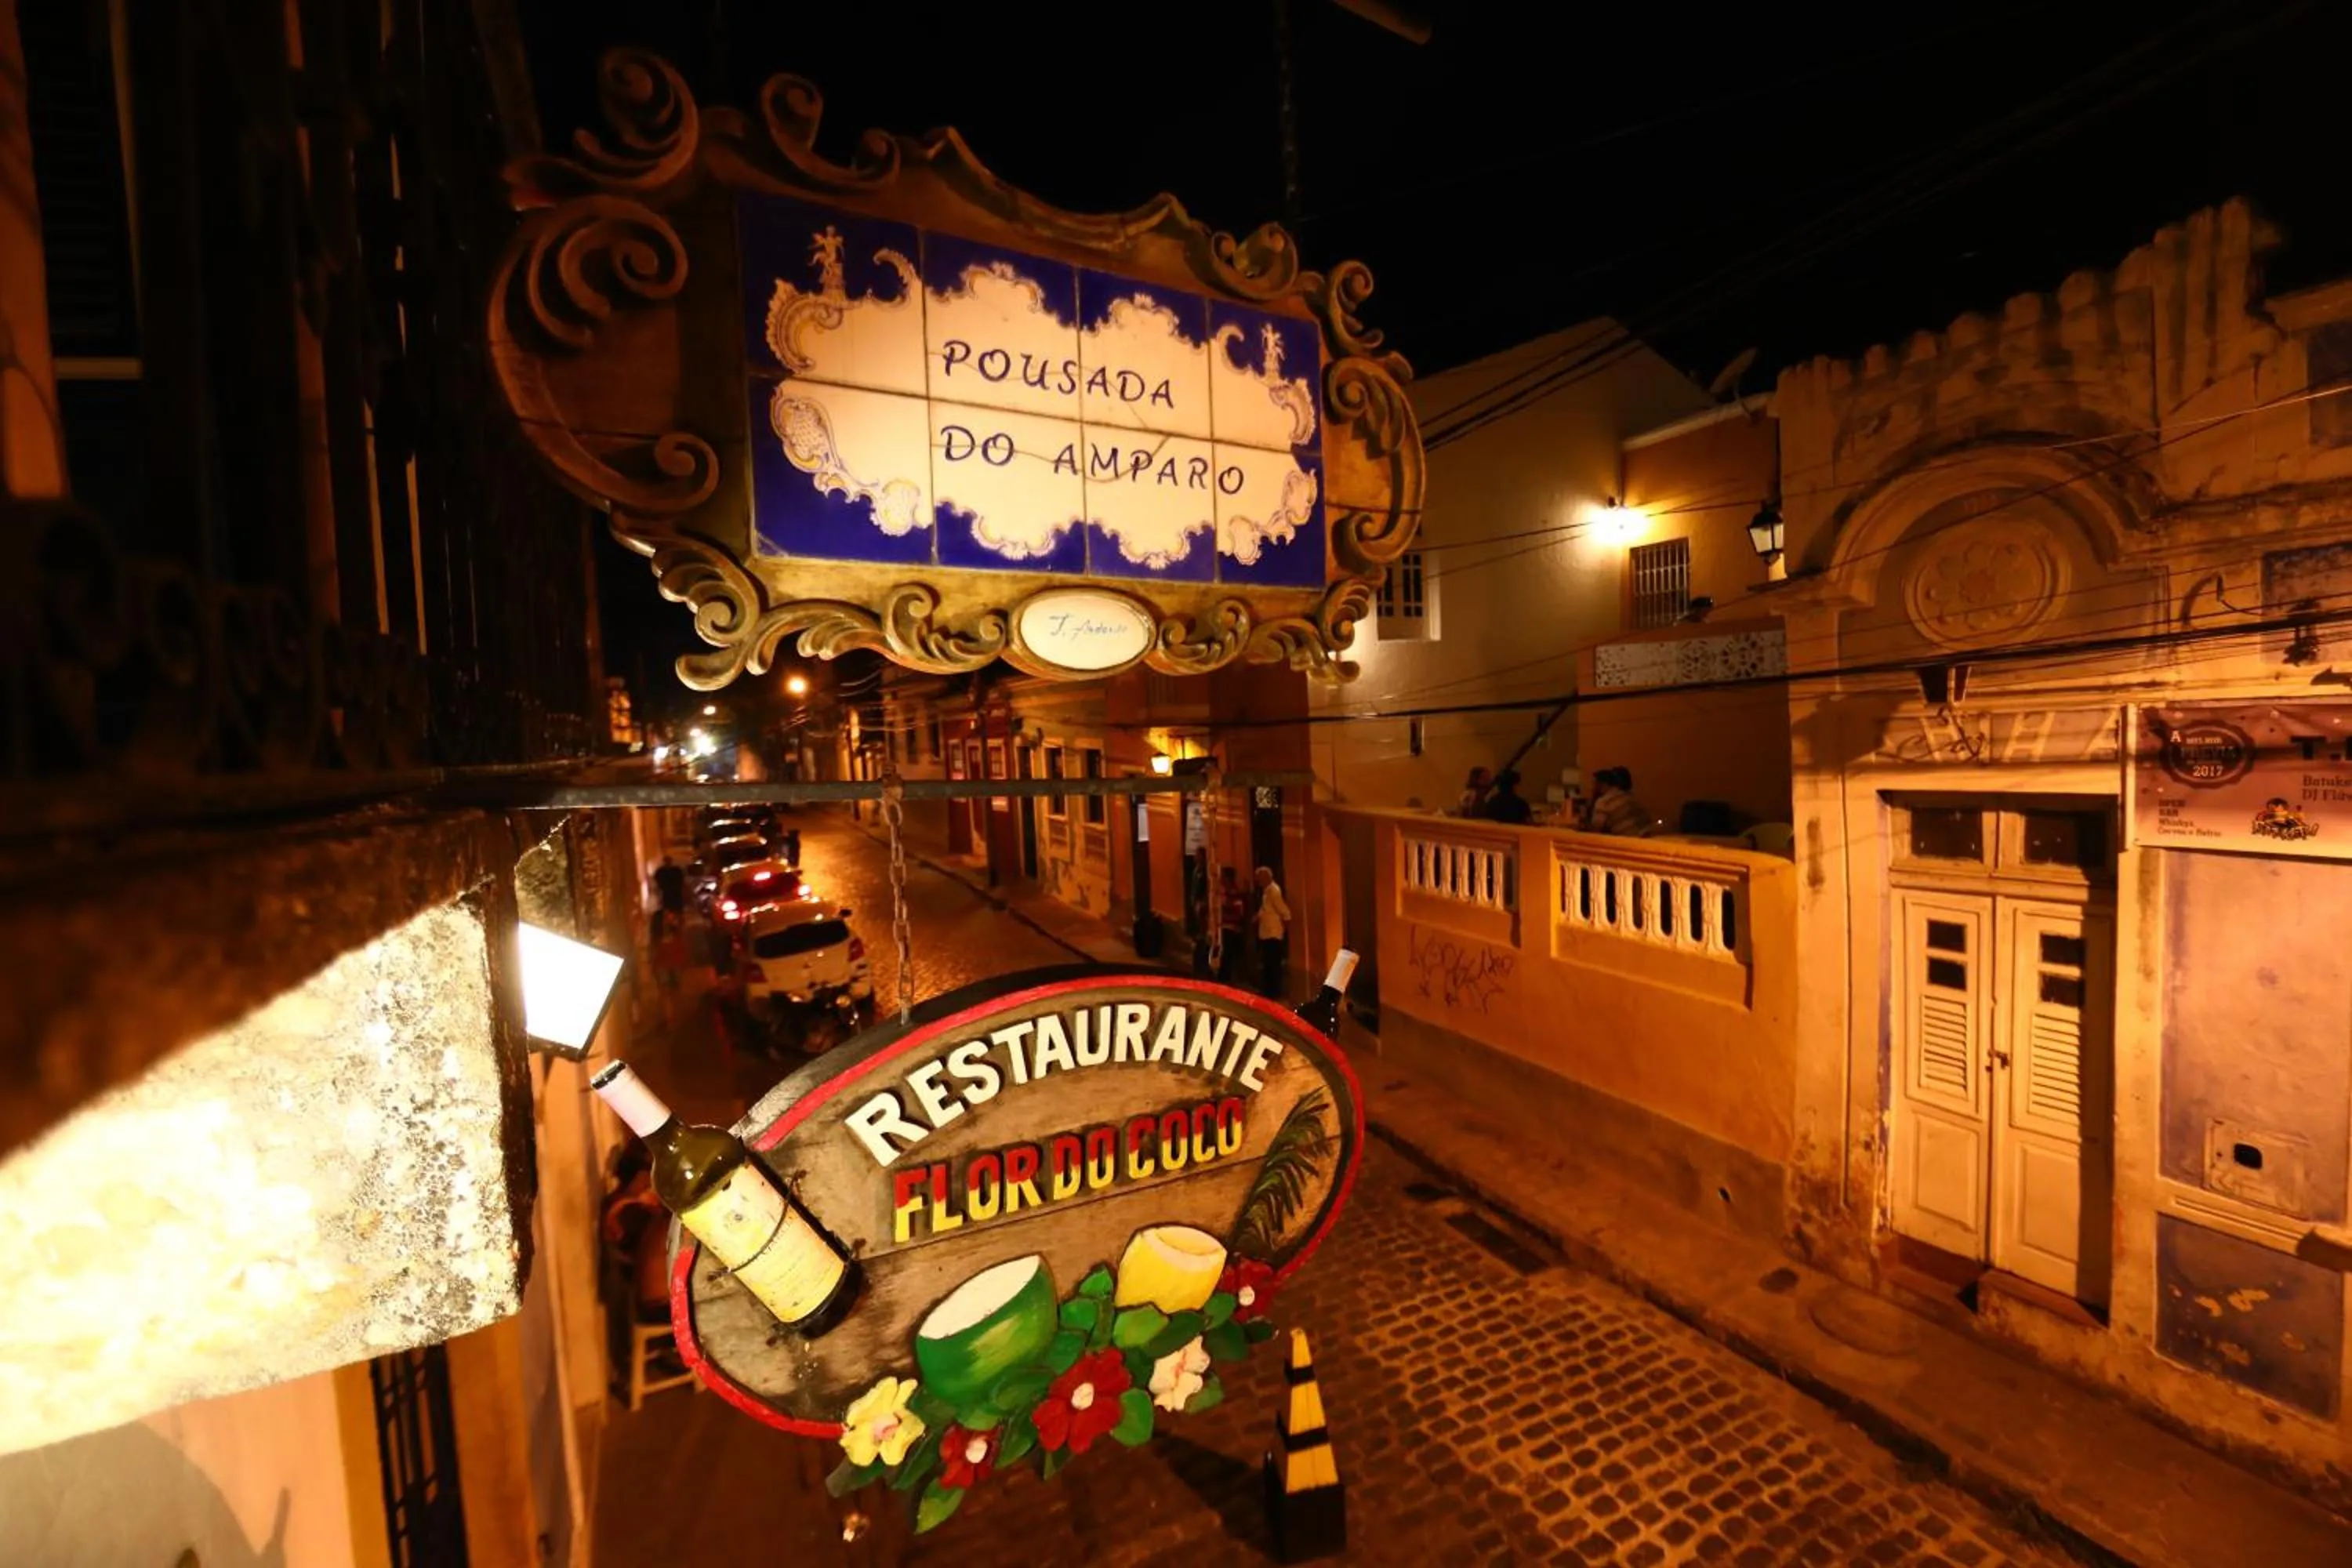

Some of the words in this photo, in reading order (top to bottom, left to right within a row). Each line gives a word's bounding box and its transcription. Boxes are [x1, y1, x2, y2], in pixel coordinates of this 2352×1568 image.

[942, 340, 1174, 409] POUSADA
[941, 425, 1014, 466] DO
[1054, 442, 1244, 495] AMPARO
[2170, 730, 2182, 743] A
[2193, 764, 2223, 777] 2017
[844, 1003, 1283, 1167] RESTAURANTE
[891, 1145, 1044, 1243] FLOR
[1051, 1127, 1116, 1201] DO
[1127, 1098, 1244, 1180] COCO
